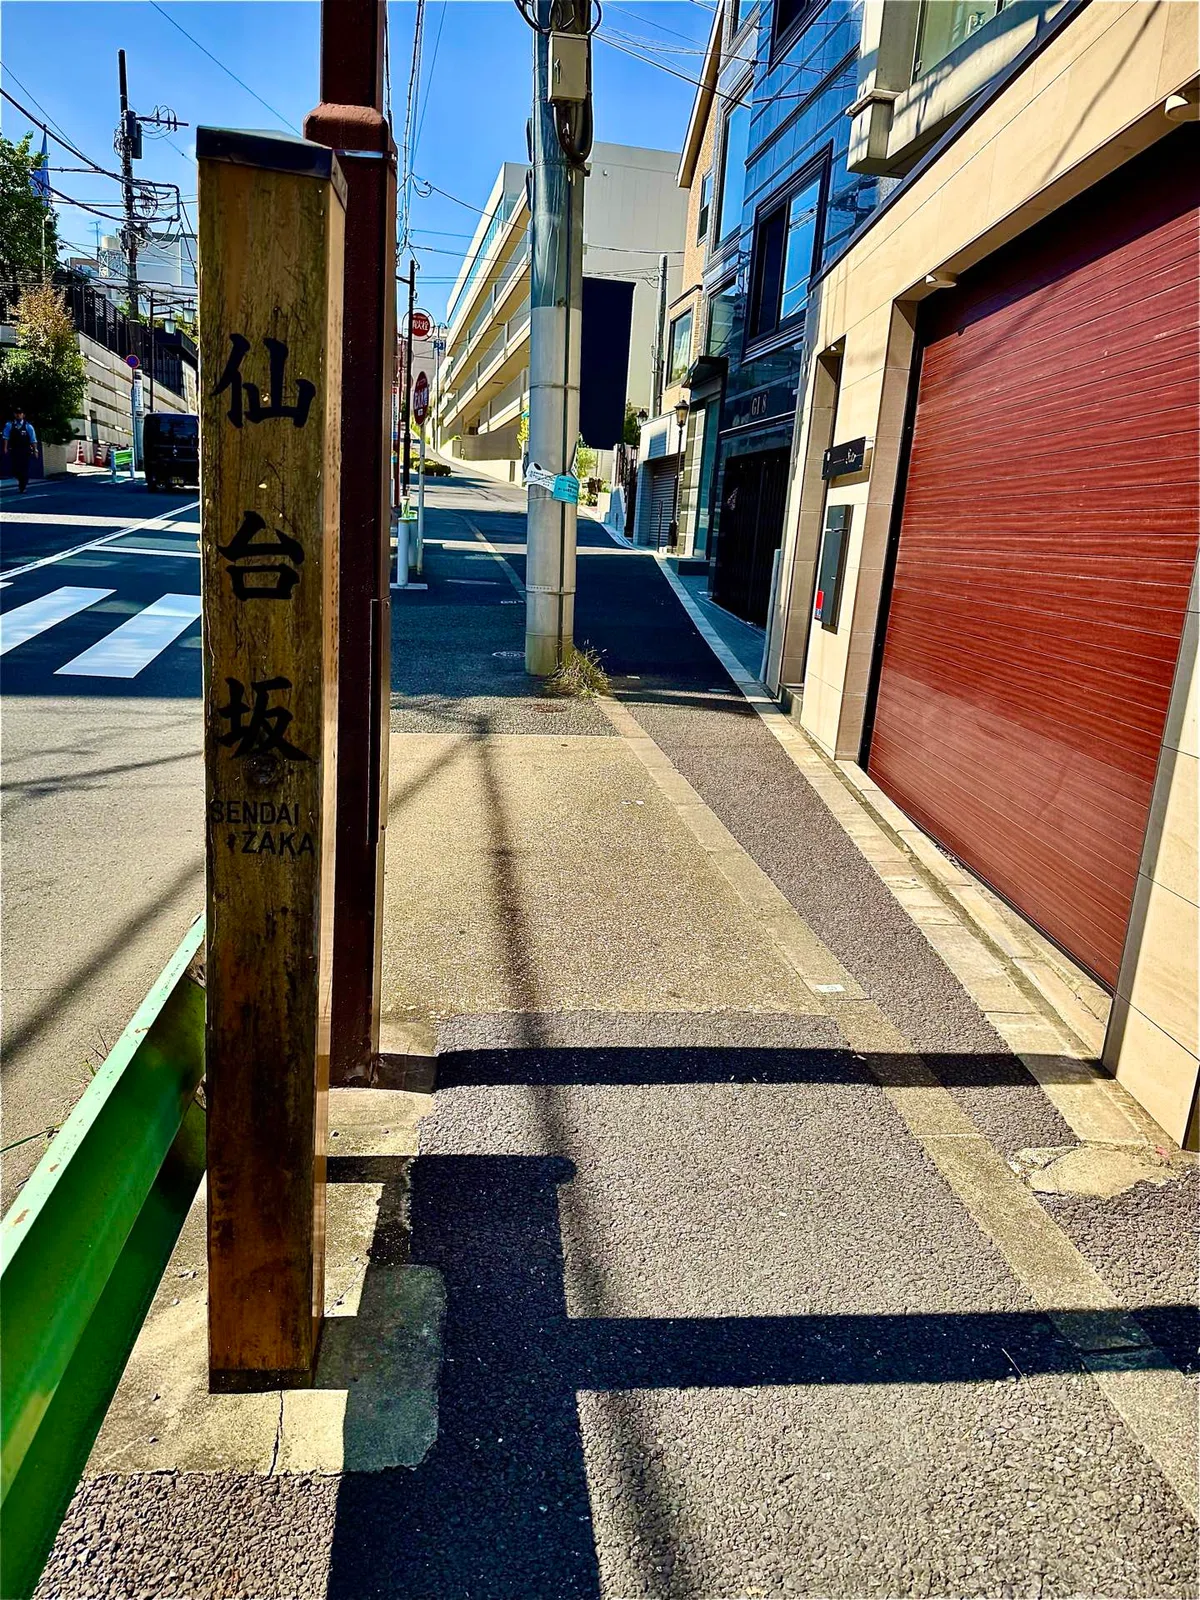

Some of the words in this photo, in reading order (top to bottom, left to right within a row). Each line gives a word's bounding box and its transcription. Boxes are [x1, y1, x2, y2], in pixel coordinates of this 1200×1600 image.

[210, 333, 314, 761] 仙台坂
[208, 800, 299, 826] SENDAI
